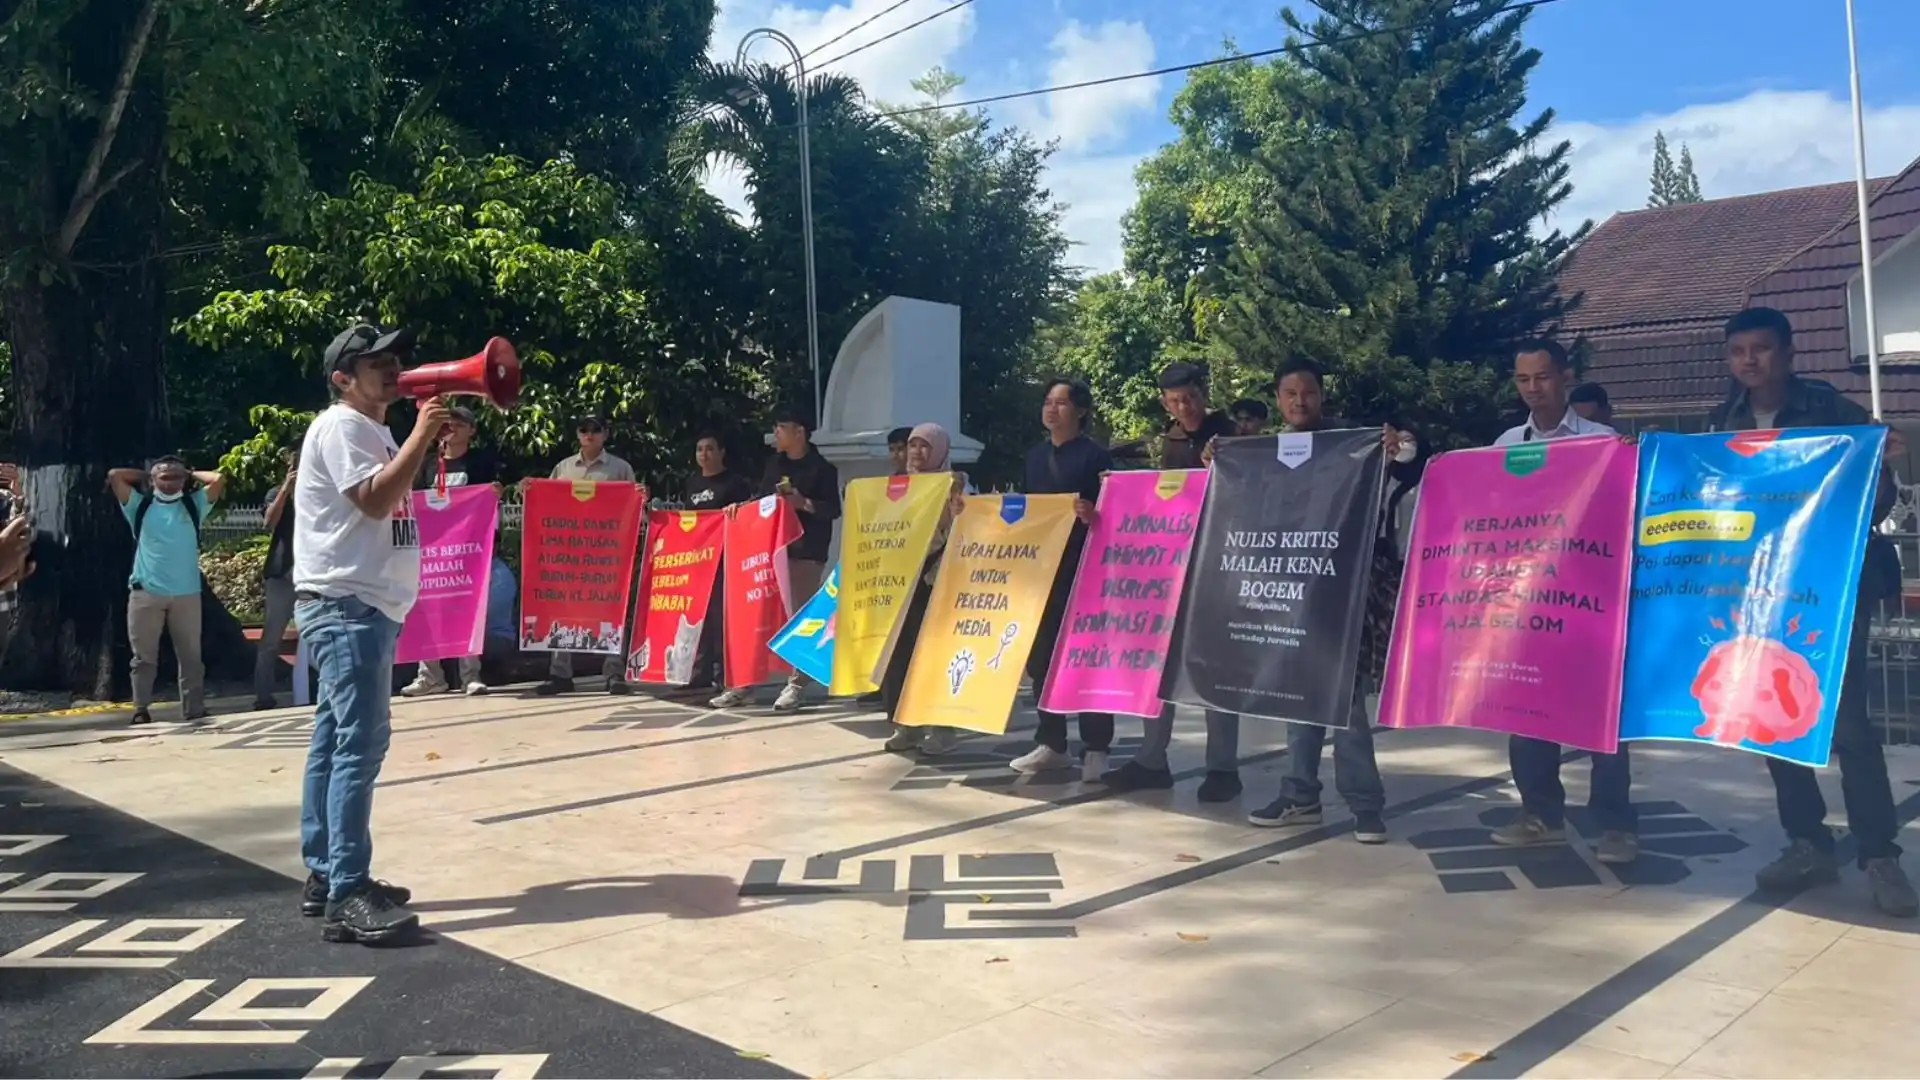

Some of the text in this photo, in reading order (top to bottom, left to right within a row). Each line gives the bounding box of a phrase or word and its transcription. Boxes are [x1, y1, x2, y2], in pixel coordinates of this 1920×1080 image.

[1464, 513, 1566, 532] KERJANYA
[1224, 530, 1339, 549] NULIS KRITIS
[440, 542, 483, 557] BERITA
[961, 542, 1040, 560] UPAH LAYAK
[1421, 538, 1615, 561] DIMINTA MAKSIMAL
[422, 559, 464, 574] MALAH
[741, 551, 770, 572] LIBUR
[1220, 555, 1336, 576] MALAH KENA
[970, 568, 1012, 585] UNTUK
[746, 587, 762, 603] NO
[1238, 580, 1305, 600] BOGEM
[954, 592, 1009, 611] PEKERJA
[953, 618, 991, 637] MEDIA
[1444, 614, 1564, 634] AJA BELOM
